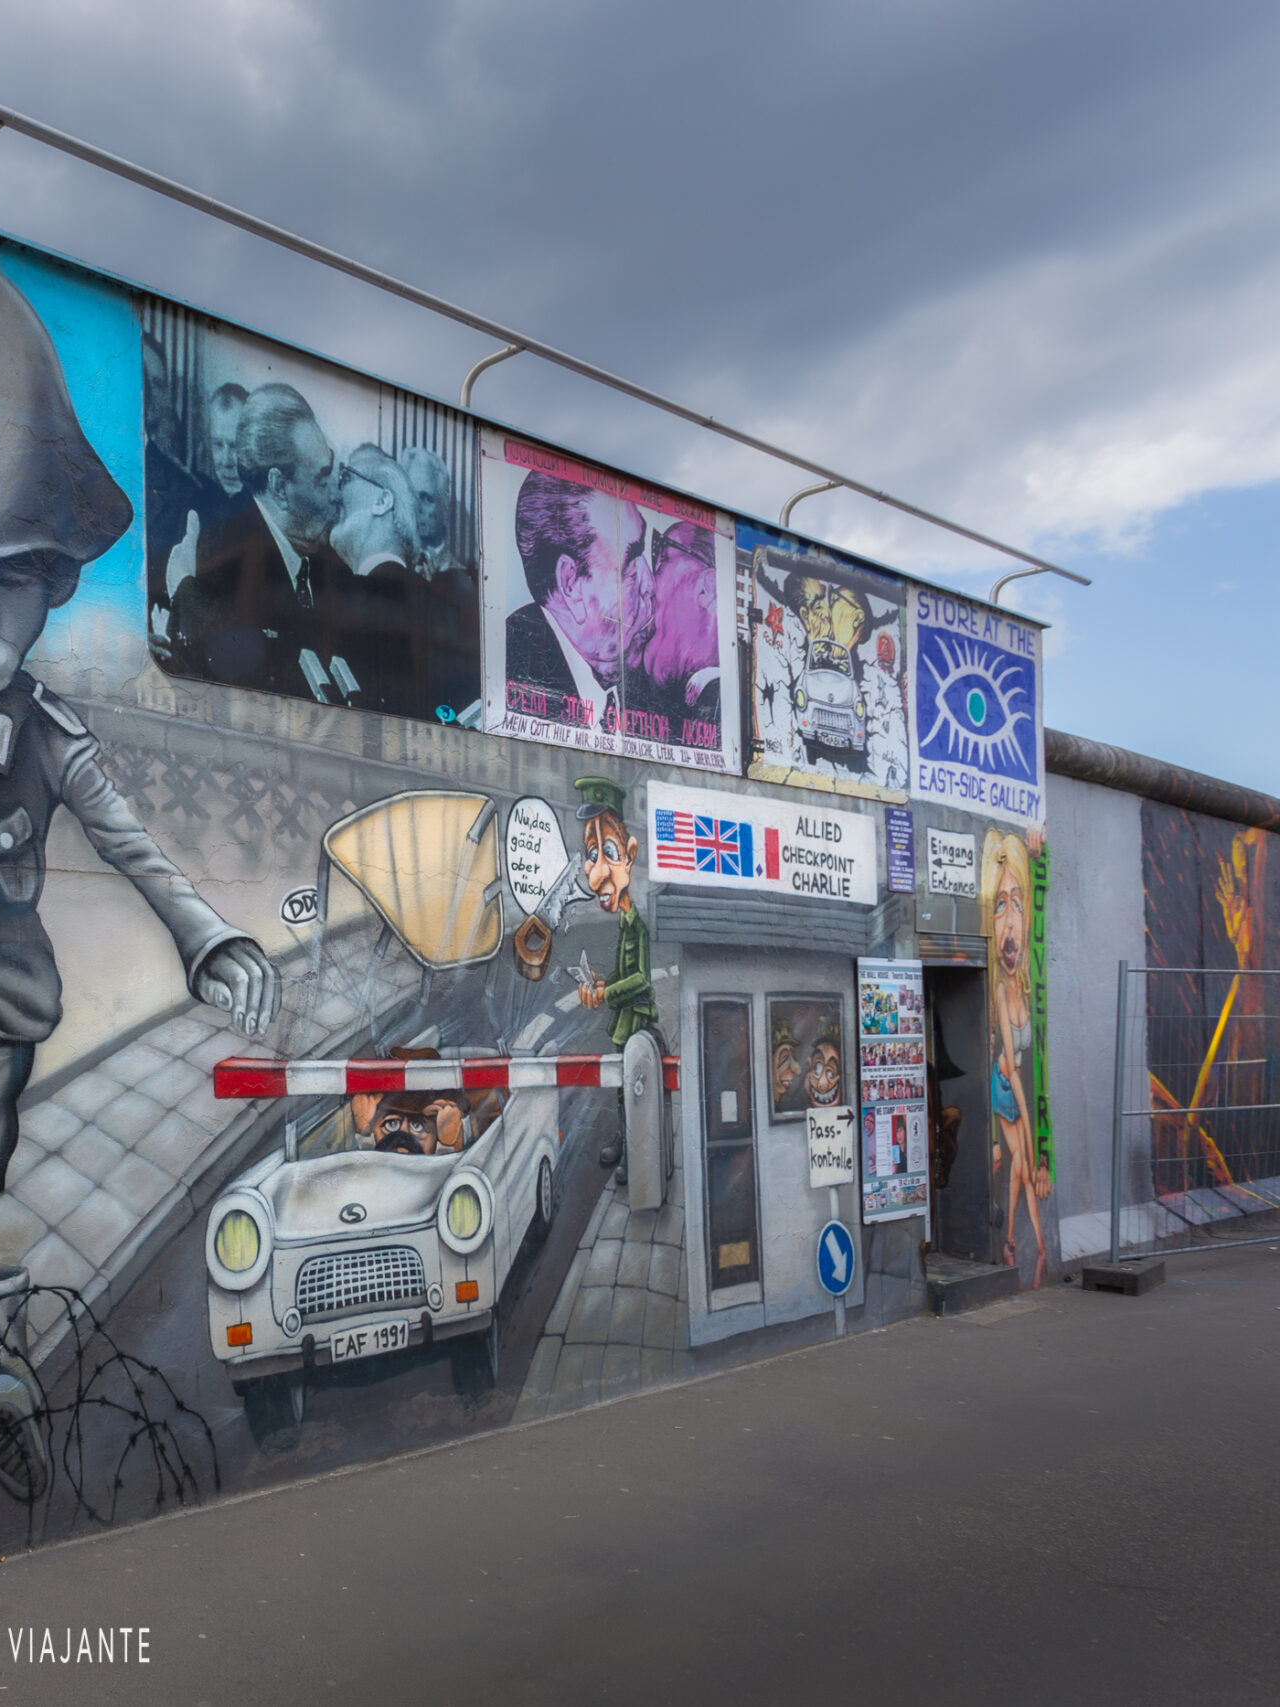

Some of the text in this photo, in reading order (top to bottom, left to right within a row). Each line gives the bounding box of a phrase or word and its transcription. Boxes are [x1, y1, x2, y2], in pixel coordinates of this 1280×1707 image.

[917, 590, 1036, 657] STORE AT THE
[502, 712, 529, 734] MEIN
[553, 724, 572, 743] HILF
[919, 764, 1040, 820] EAST-SIDE GALLERY
[796, 816, 842, 843] ALLIED
[782, 845, 855, 875] CHECKPOINT
[930, 837, 974, 866] Eingang
[511, 857, 540, 874] ober
[792, 871, 850, 898] CHARLIE
[931, 871, 975, 895] Entrance
[809, 1116, 841, 1140] Pass-
[810, 1146, 852, 1170] kontrolle
[373, 1323, 406, 1349] 1991
